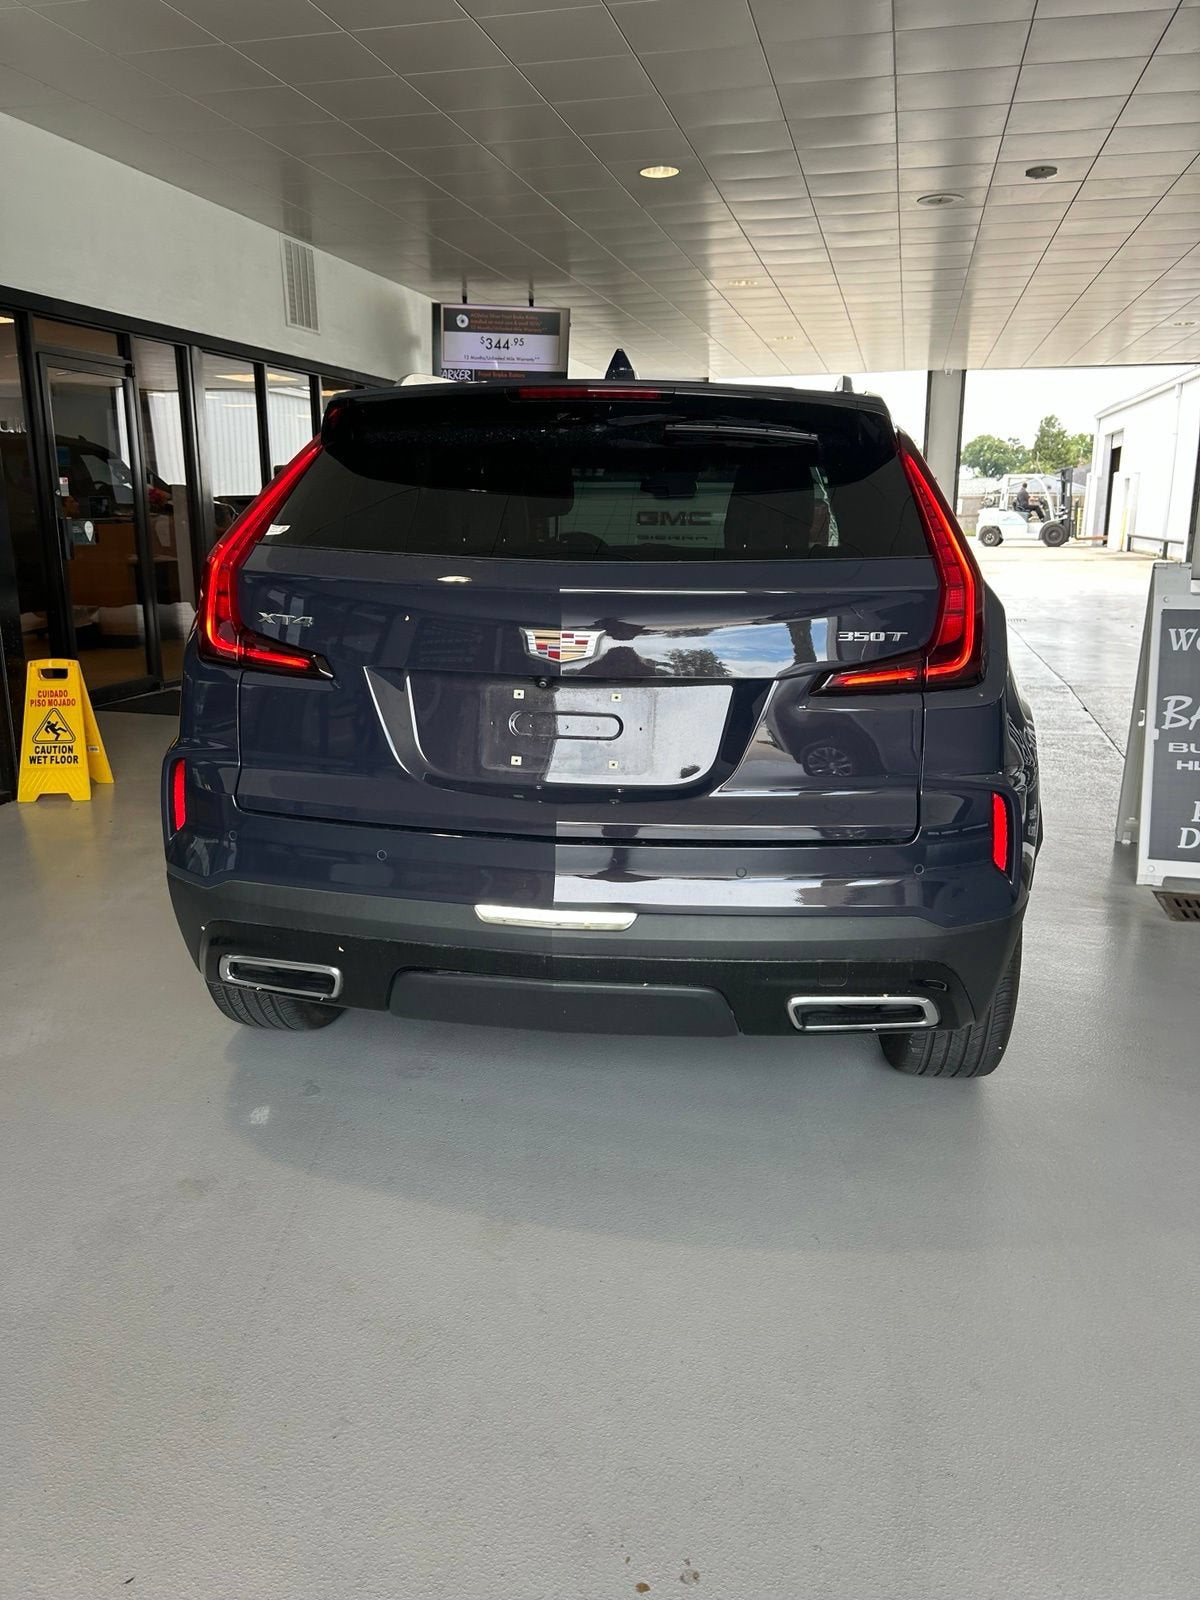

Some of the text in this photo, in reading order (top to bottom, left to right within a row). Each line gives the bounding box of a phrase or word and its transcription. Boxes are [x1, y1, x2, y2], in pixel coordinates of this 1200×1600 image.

[480, 336, 525, 351] $344.95
[440, 369, 471, 381] ARKER
[636, 511, 713, 526] GMC
[256, 611, 313, 627] XT4
[37, 690, 68, 699] CUIDADO
[30, 698, 76, 707] PISO MOJADO
[34, 745, 74, 754] CAUTION
[29, 755, 79, 764] WET FLOOR
